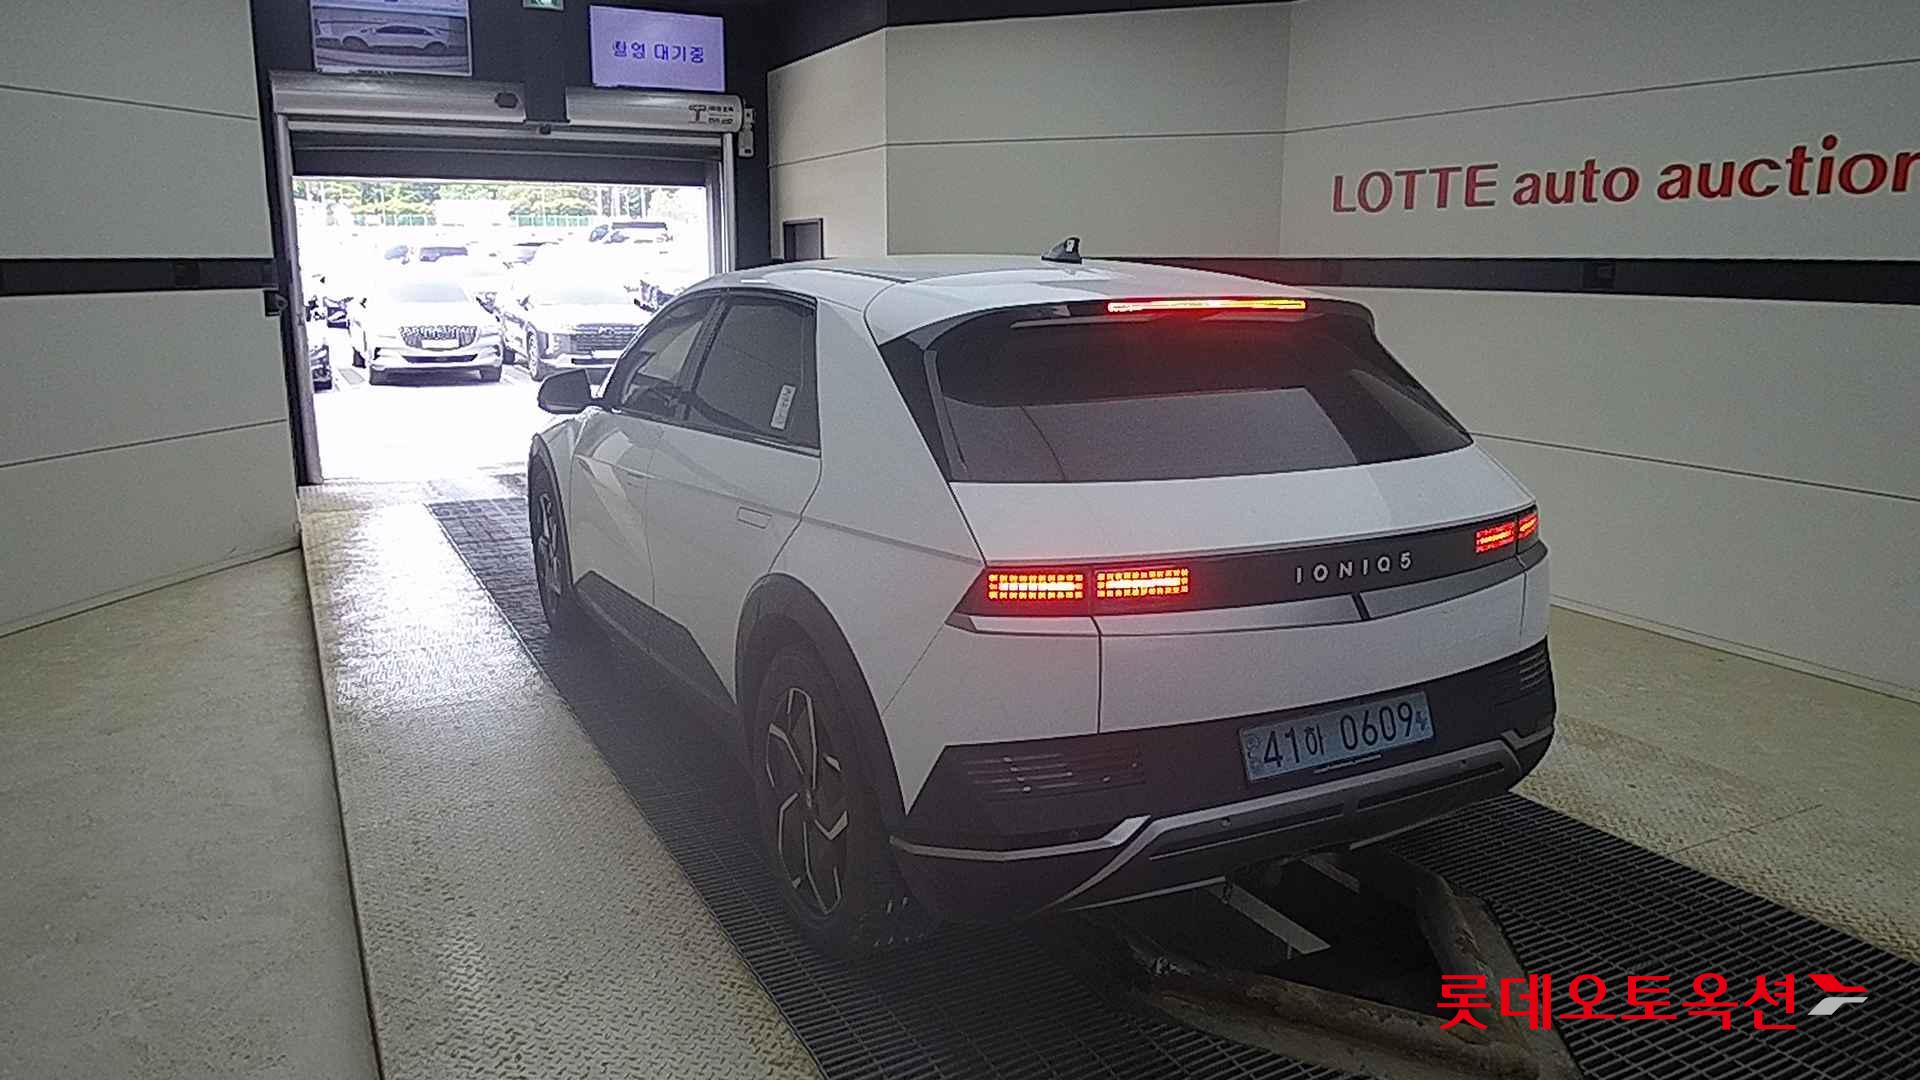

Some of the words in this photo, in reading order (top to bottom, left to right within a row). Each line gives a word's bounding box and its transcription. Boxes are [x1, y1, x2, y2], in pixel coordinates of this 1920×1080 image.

[1332, 164, 1499, 213] LOTTE
[1513, 159, 1640, 206] auto
[1263, 723, 1325, 767] 41하
[1340, 702, 1413, 750] 0609
